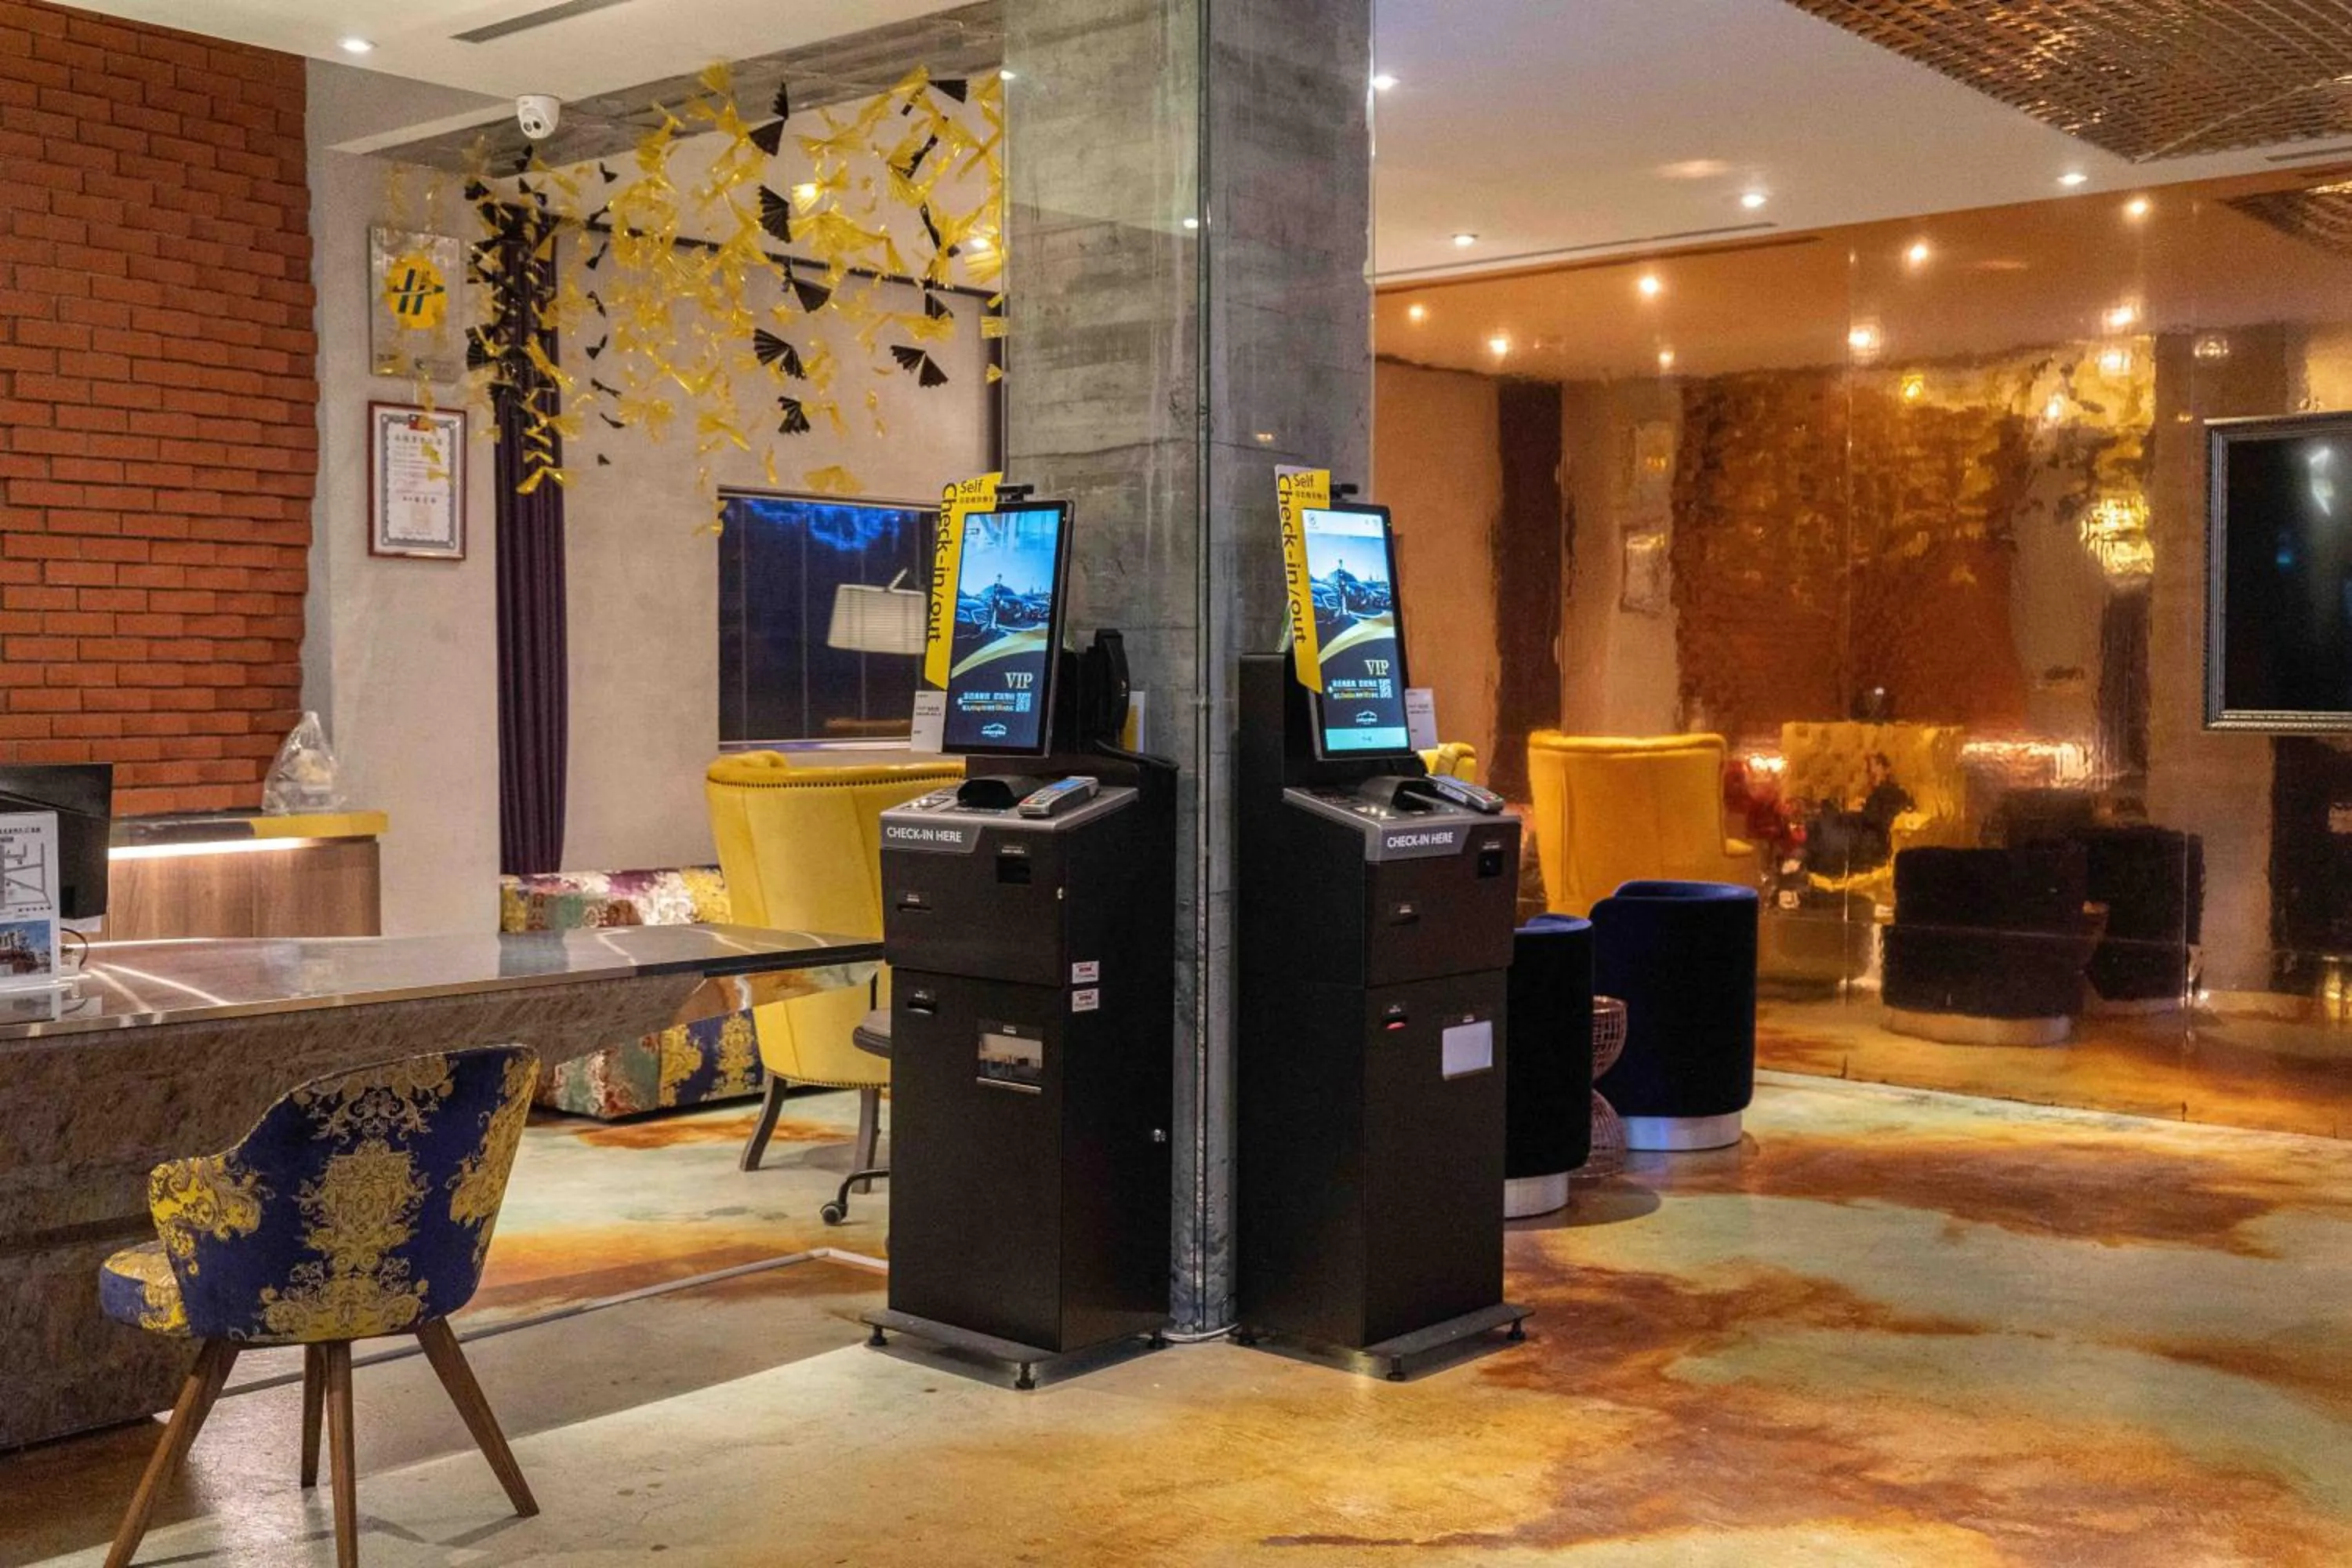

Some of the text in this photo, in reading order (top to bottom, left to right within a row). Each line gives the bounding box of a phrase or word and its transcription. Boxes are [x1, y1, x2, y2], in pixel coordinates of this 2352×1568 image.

[960, 479, 983, 493] Self
[1292, 473, 1314, 488] Self
[927, 482, 957, 641] Check-in/out
[1277, 474, 1307, 644] Check-in/out
[1363, 659, 1390, 675] VIP
[1004, 672, 1033, 689] VIP
[887, 826, 962, 843] CHECK-IN HERE
[1387, 832, 1454, 848] CHECK-IN HERE
